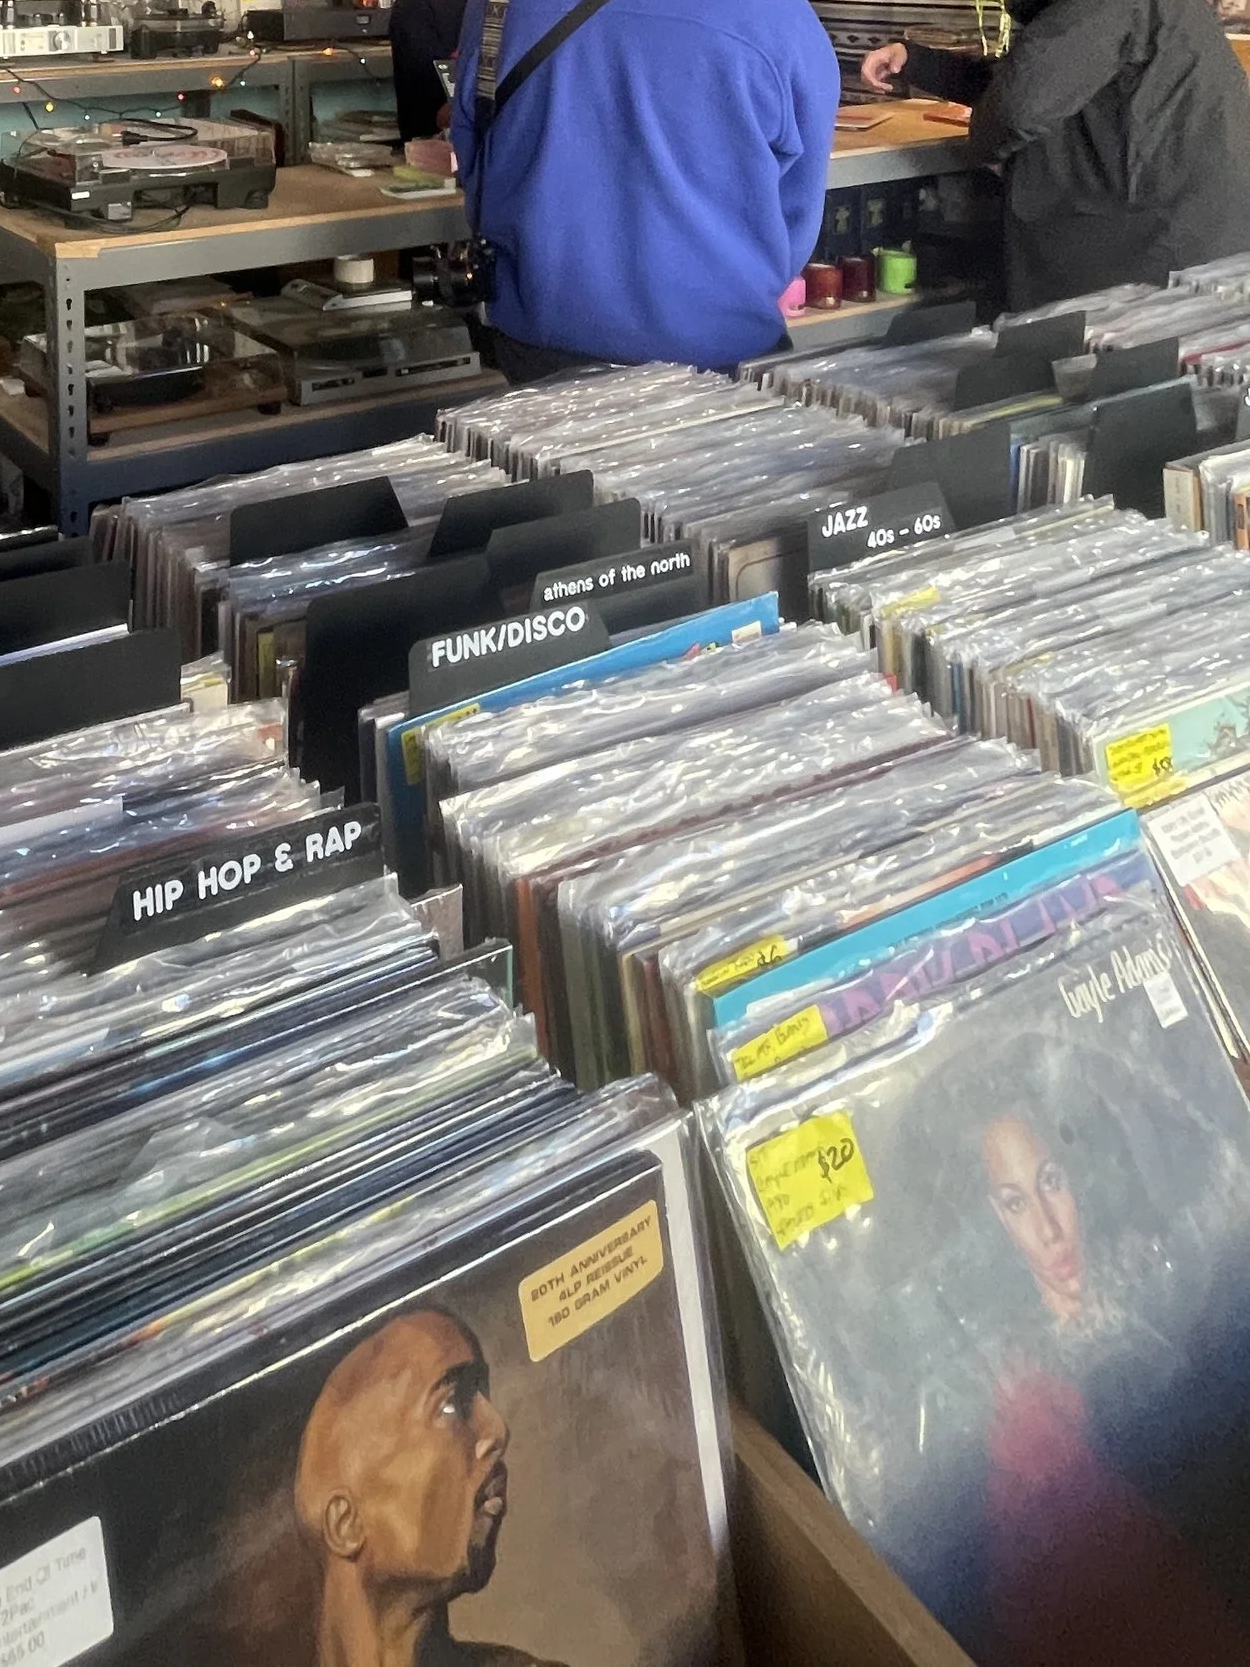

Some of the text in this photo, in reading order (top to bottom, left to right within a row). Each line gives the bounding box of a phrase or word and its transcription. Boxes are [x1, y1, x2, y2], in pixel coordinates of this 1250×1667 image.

[822, 506, 868, 537] JAZZ
[866, 527, 894, 549] 40s
[913, 514, 941, 535] 60s
[544, 551, 691, 602] athens of the north
[431, 606, 586, 668] FUNK/DISCO
[132, 821, 362, 921] HIP HOP & RAP
[817, 1137, 855, 1184] $20
[530, 1214, 653, 1303] 20TH ANNIVERSARY
[557, 1248, 635, 1301] 4LP REISSUE
[547, 1254, 650, 1329] 180 GRAM VINYL
[6, 1576, 32, 1603] End
[56, 1547, 86, 1570] Time
